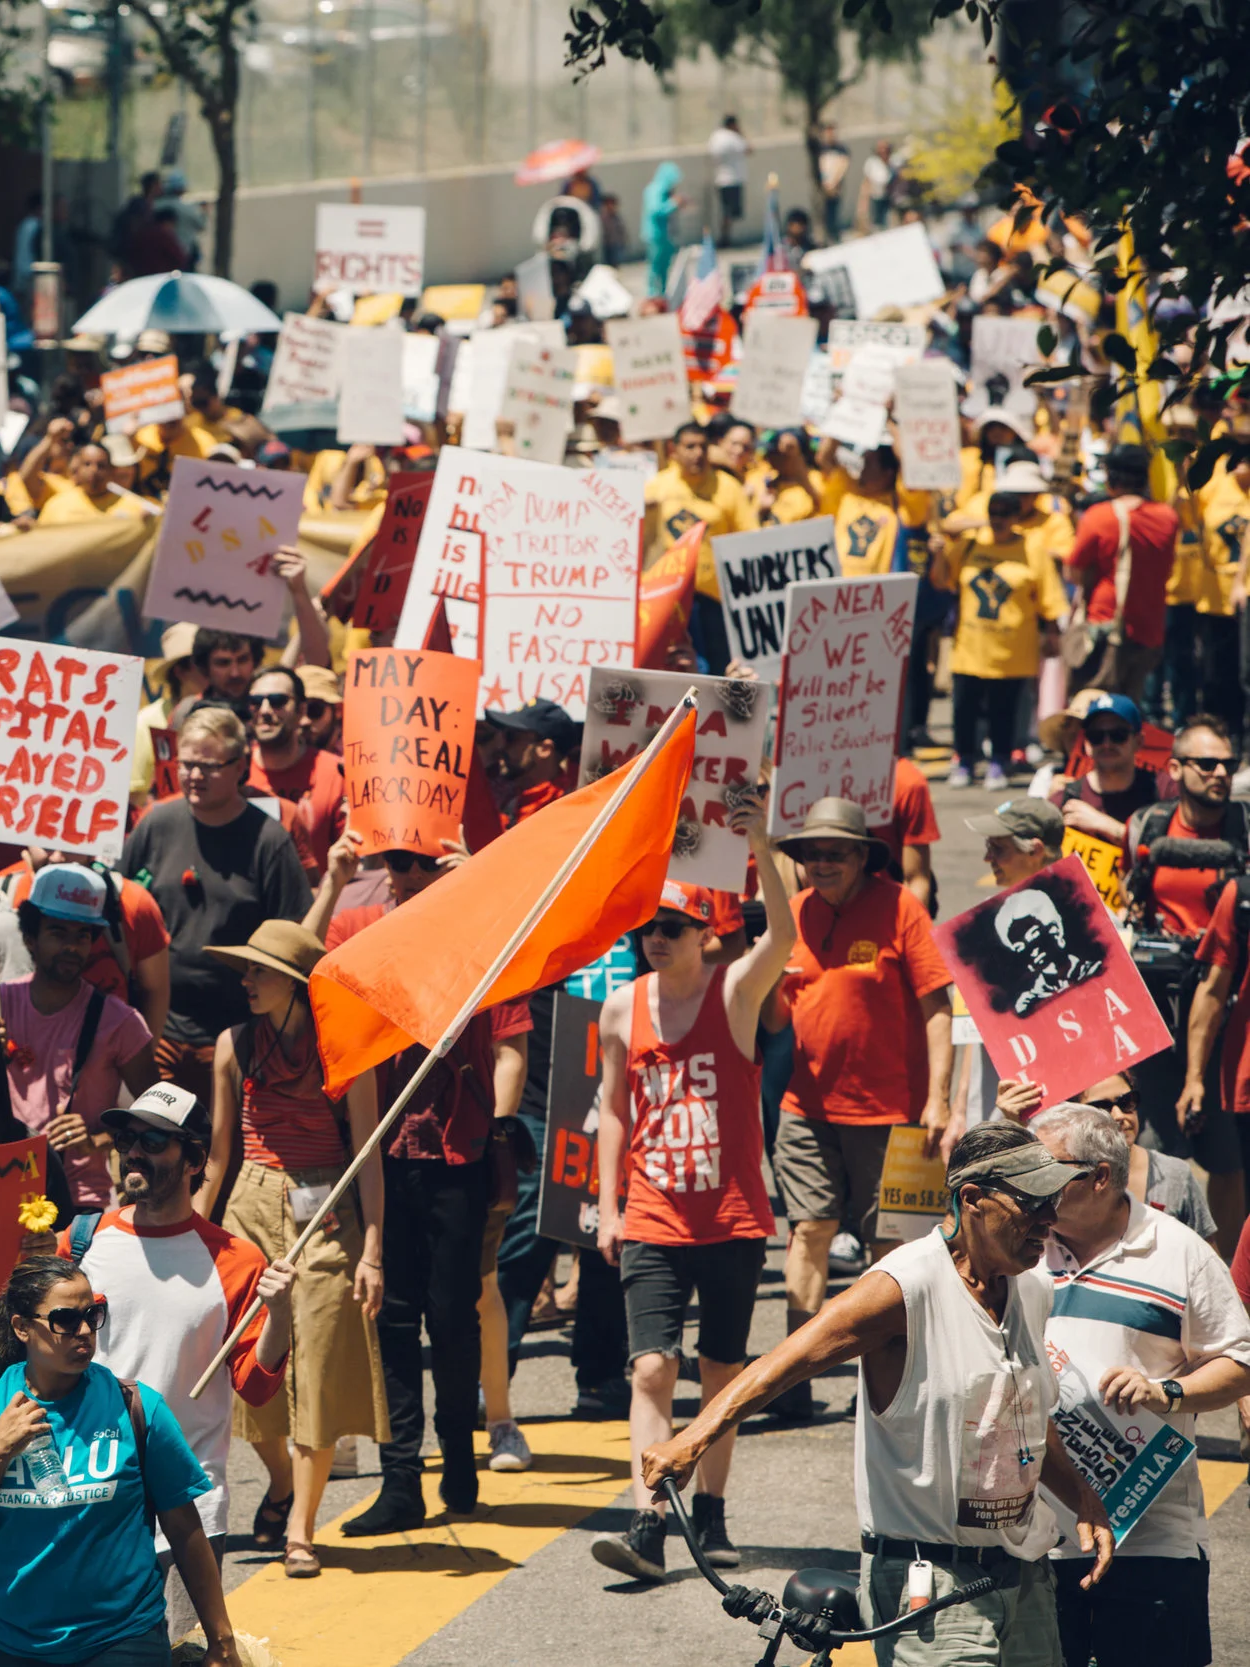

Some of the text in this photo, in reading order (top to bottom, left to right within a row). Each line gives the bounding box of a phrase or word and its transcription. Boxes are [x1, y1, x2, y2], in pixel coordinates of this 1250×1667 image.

[315, 250, 421, 287] RIGHTS
[441, 535, 466, 563] is
[432, 568, 481, 599] ille
[503, 561, 610, 589] TRUMP
[723, 544, 835, 600] WORKERS
[534, 603, 584, 628] NO
[833, 582, 886, 616] NEA
[731, 601, 785, 660] UNI
[507, 632, 635, 665] FASCIST
[823, 631, 870, 670] WE
[353, 654, 424, 688] MAY
[864, 669, 887, 696] be
[517, 671, 588, 706] USA
[696, 709, 728, 738] A
[346, 735, 467, 779] The REAL
[351, 776, 413, 809] LABOR
[1008, 988, 1132, 1068] DSA
[638, 1053, 718, 1101] WIS
[642, 1100, 720, 1150] CON
[93, 1427, 121, 1441] SoCal
[1, 1438, 119, 1487] ALU
[975, 1510, 993, 1519] FOR
